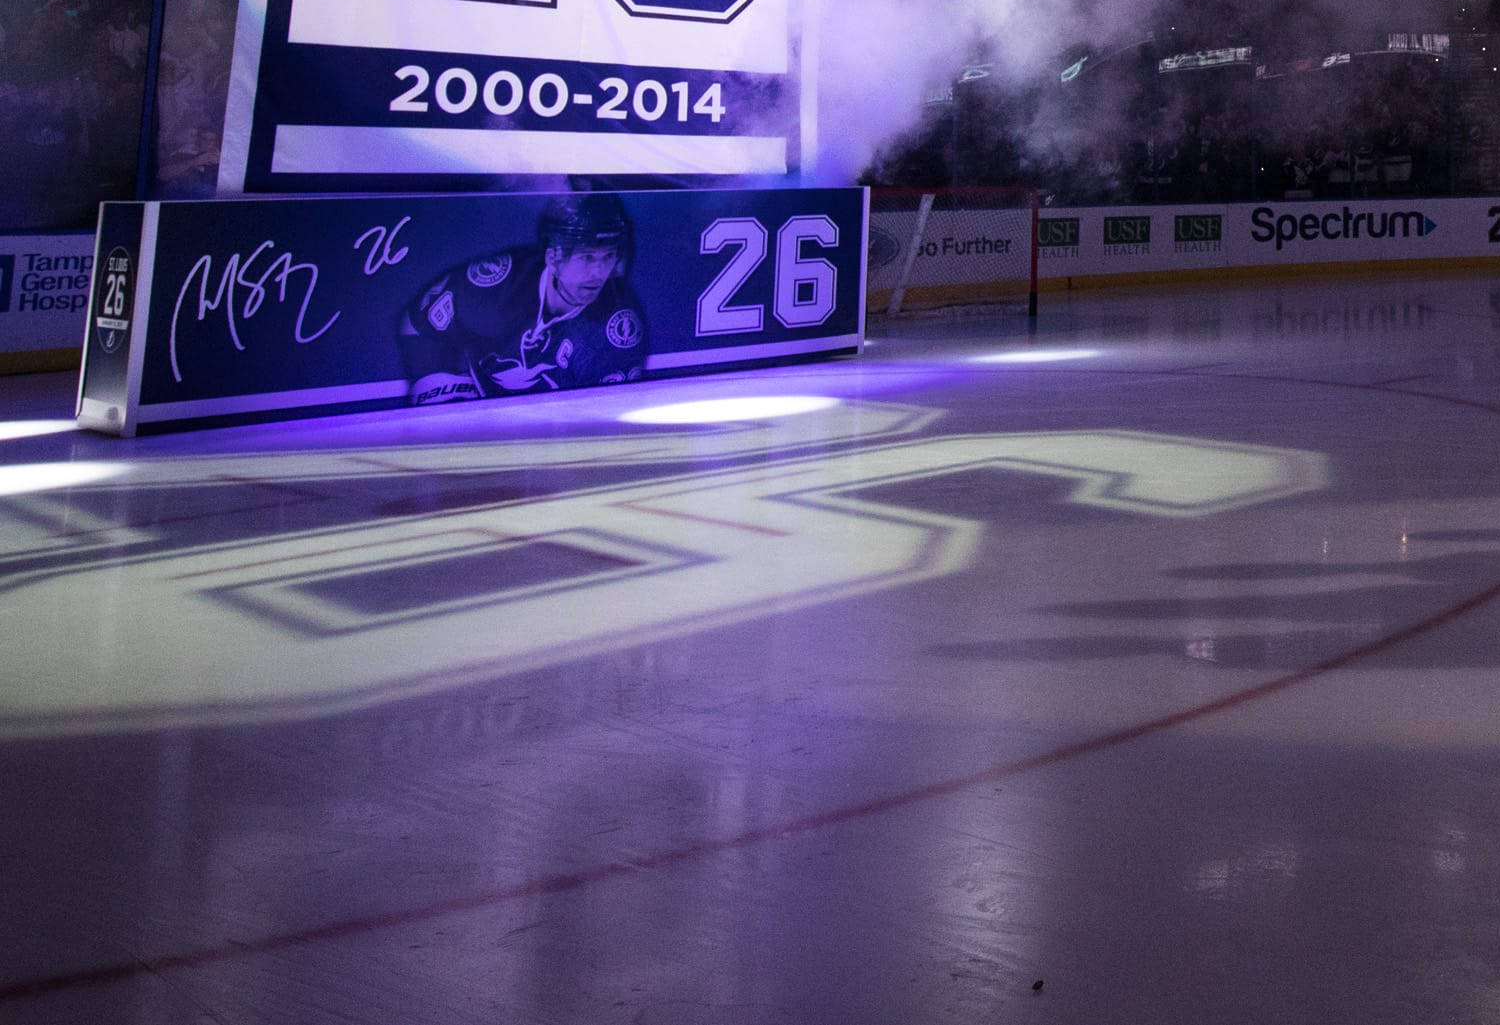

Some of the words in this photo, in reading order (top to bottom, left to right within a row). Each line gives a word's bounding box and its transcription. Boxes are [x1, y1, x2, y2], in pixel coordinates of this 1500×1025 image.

[389, 65, 727, 123] 2000-2014
[1037, 220, 1078, 244] USF
[1105, 219, 1149, 242] USF
[1177, 217, 1219, 239] USF
[1251, 207, 1425, 251] Spectrum
[354, 216, 412, 275] 26
[942, 235, 1011, 257] Further
[1104, 243, 1150, 256] HEALTH
[1174, 241, 1222, 254] HEALTH
[21, 272, 90, 292] Gene
[695, 214, 839, 337] 26
[19, 293, 87, 313] Hosp
[103, 274, 126, 316] 26
